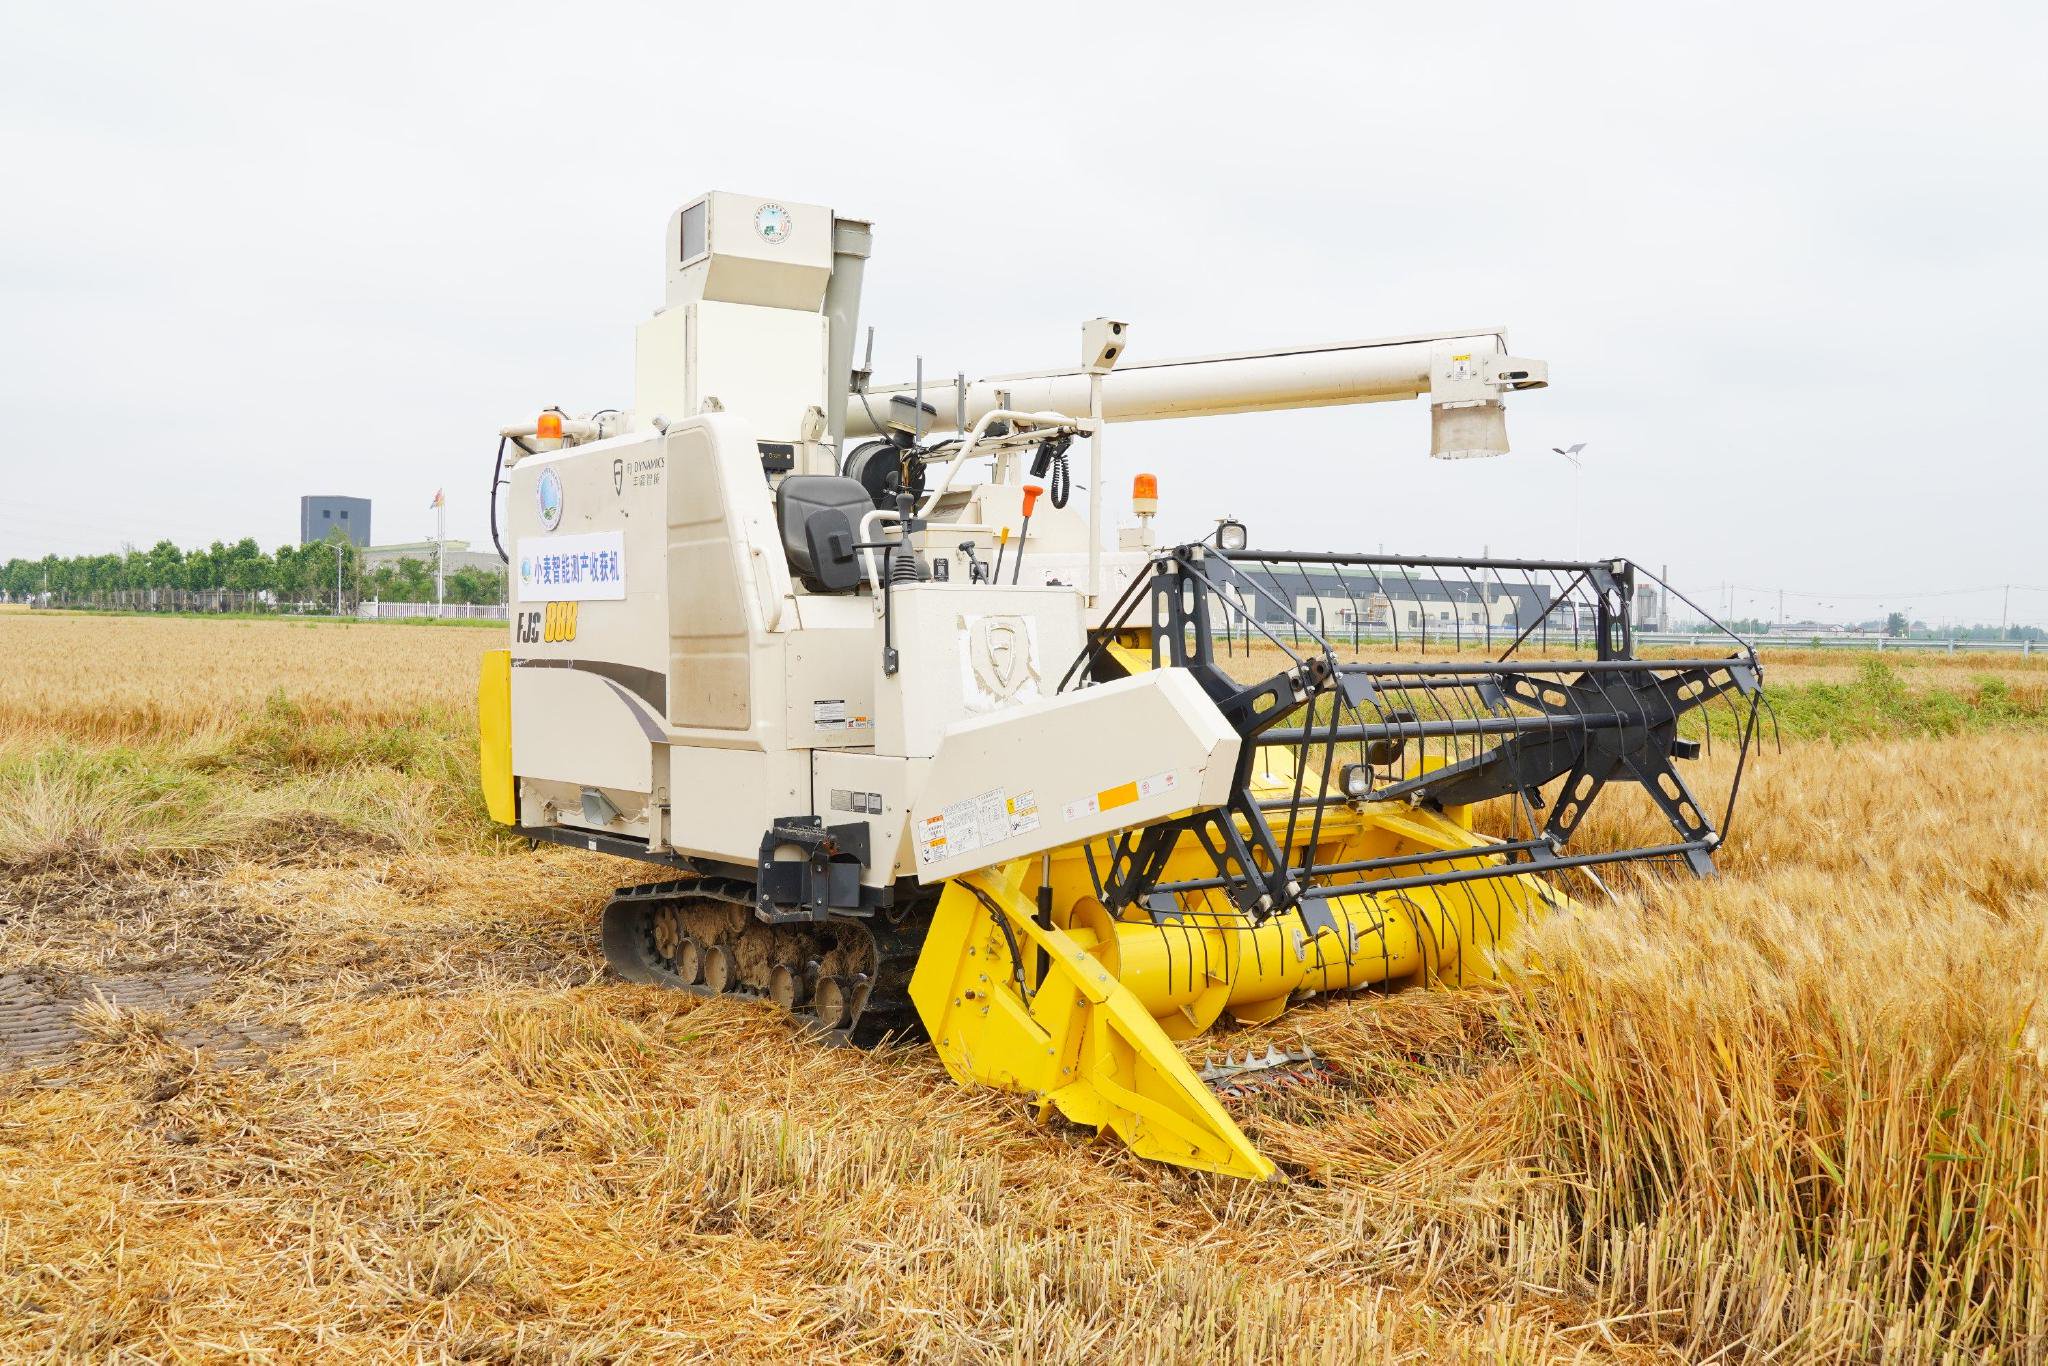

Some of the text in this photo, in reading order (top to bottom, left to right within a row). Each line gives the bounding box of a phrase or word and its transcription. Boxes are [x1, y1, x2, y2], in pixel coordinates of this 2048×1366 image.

[534, 550, 620, 584] 小麦智能测产收获机
[516, 601, 578, 643] FJC 888
